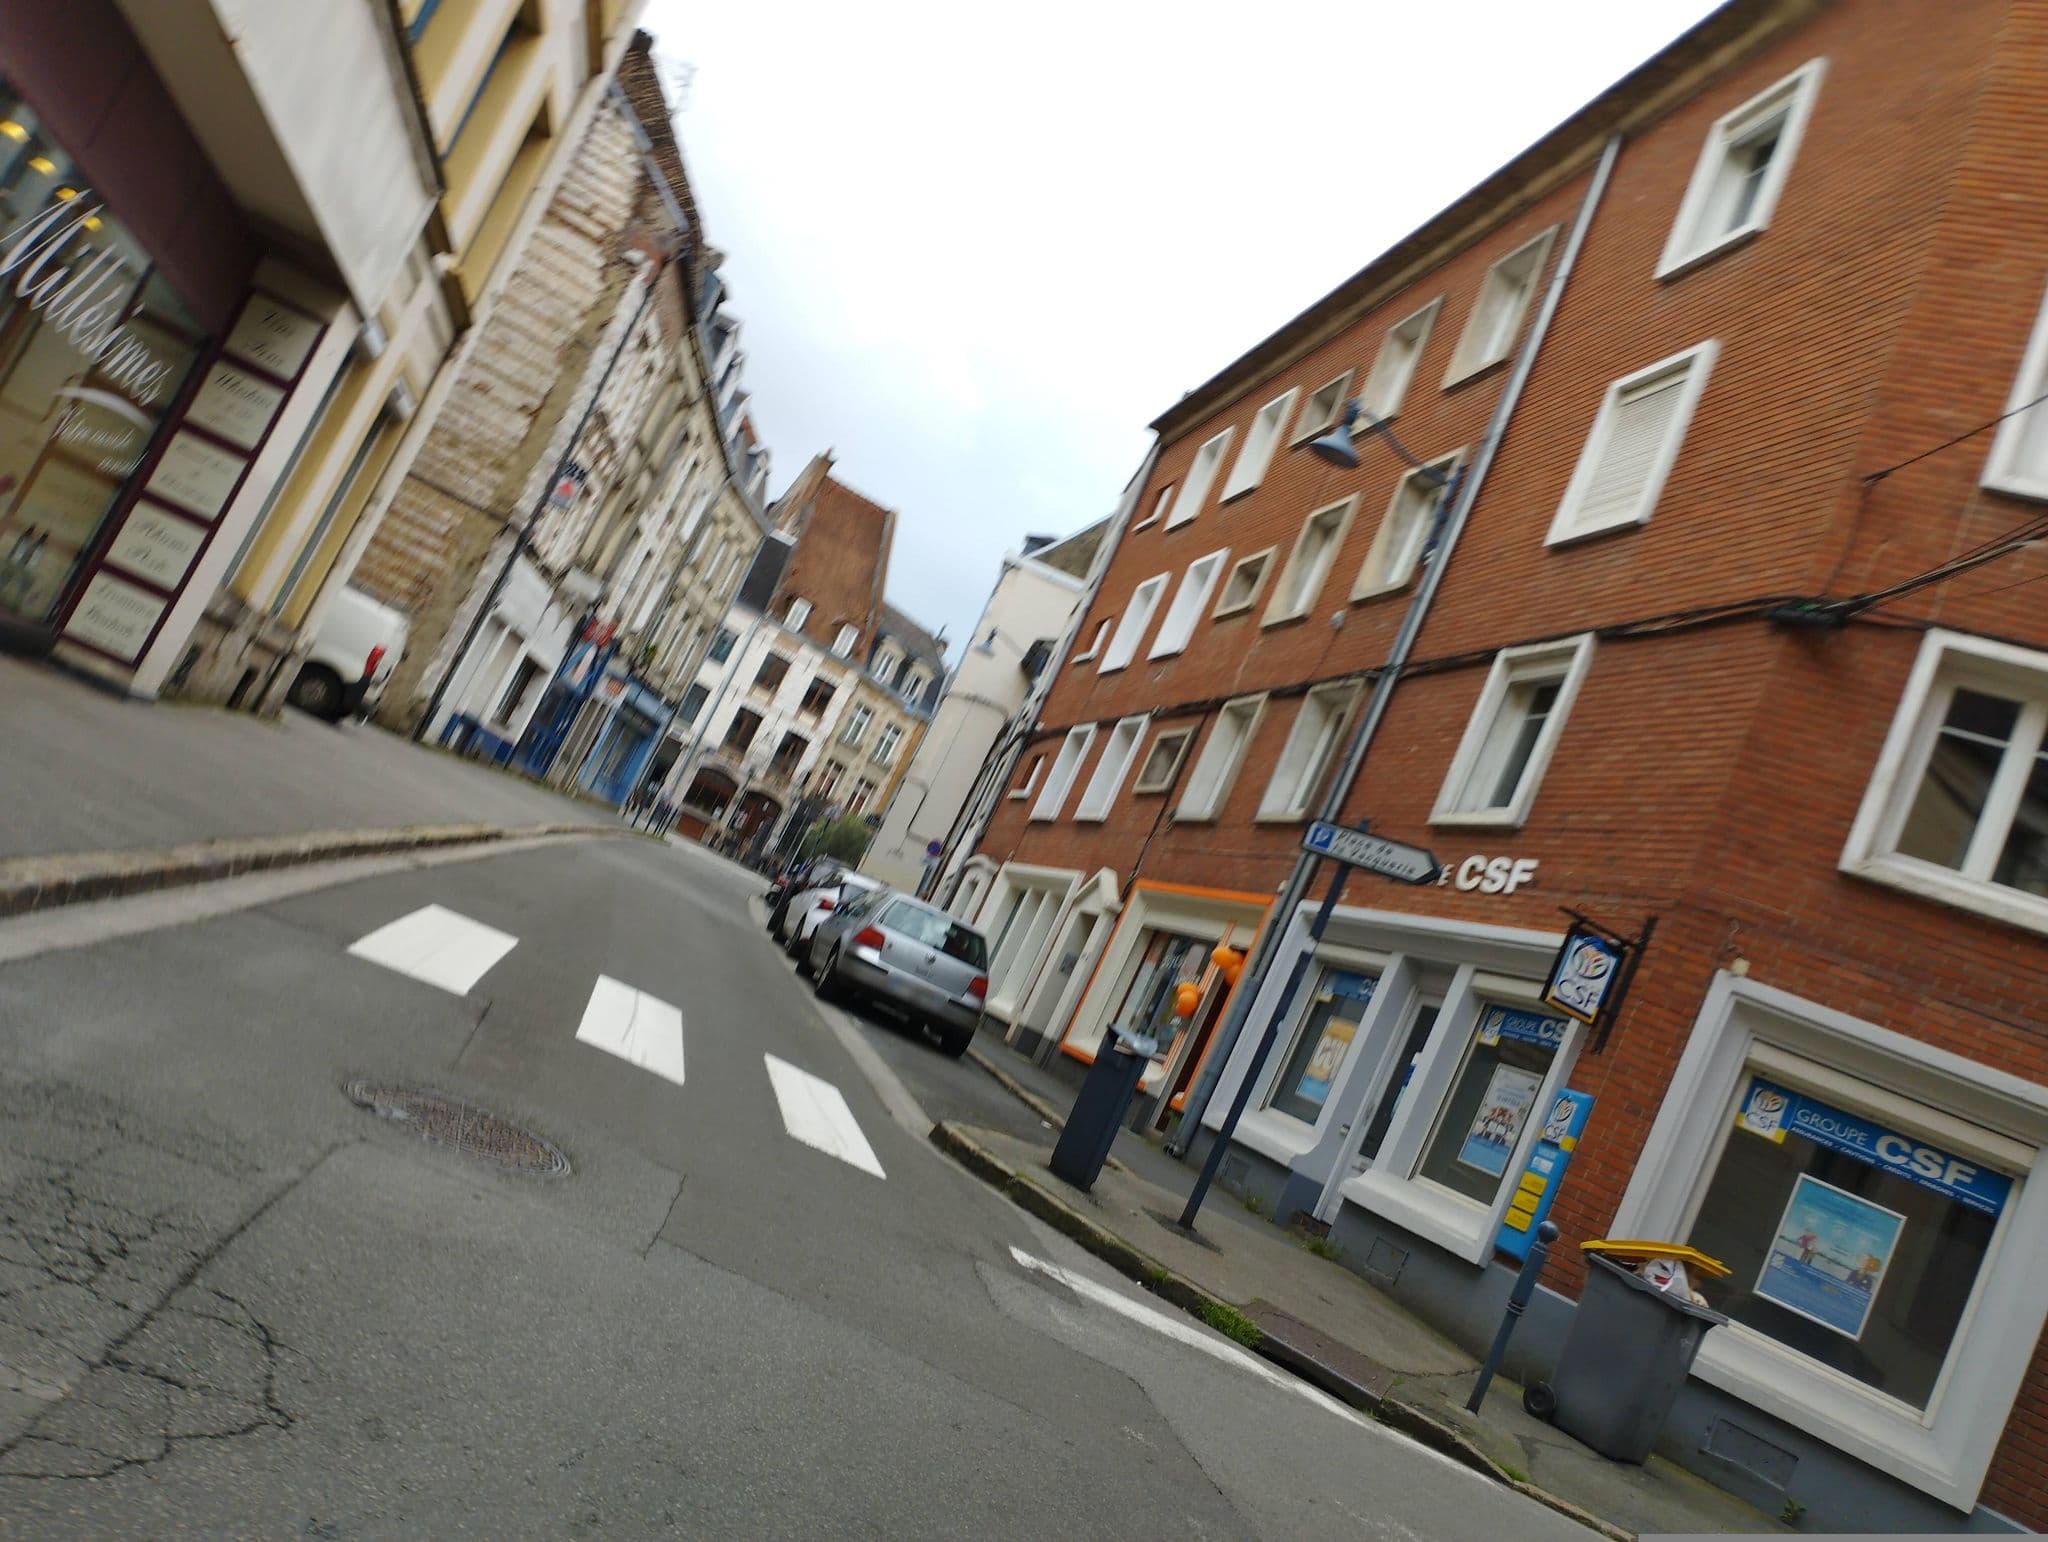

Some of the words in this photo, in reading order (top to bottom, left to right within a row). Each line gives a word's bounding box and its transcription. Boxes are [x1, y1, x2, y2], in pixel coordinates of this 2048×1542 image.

[1455, 854, 1540, 894] CSF
[1557, 978, 1601, 1009] CSF
[1543, 1122, 1566, 1140] CSF
[1744, 1111, 1778, 1132] CSF
[1796, 1109, 1869, 1147] GROUPE
[1875, 1135, 1977, 1186] CSF
